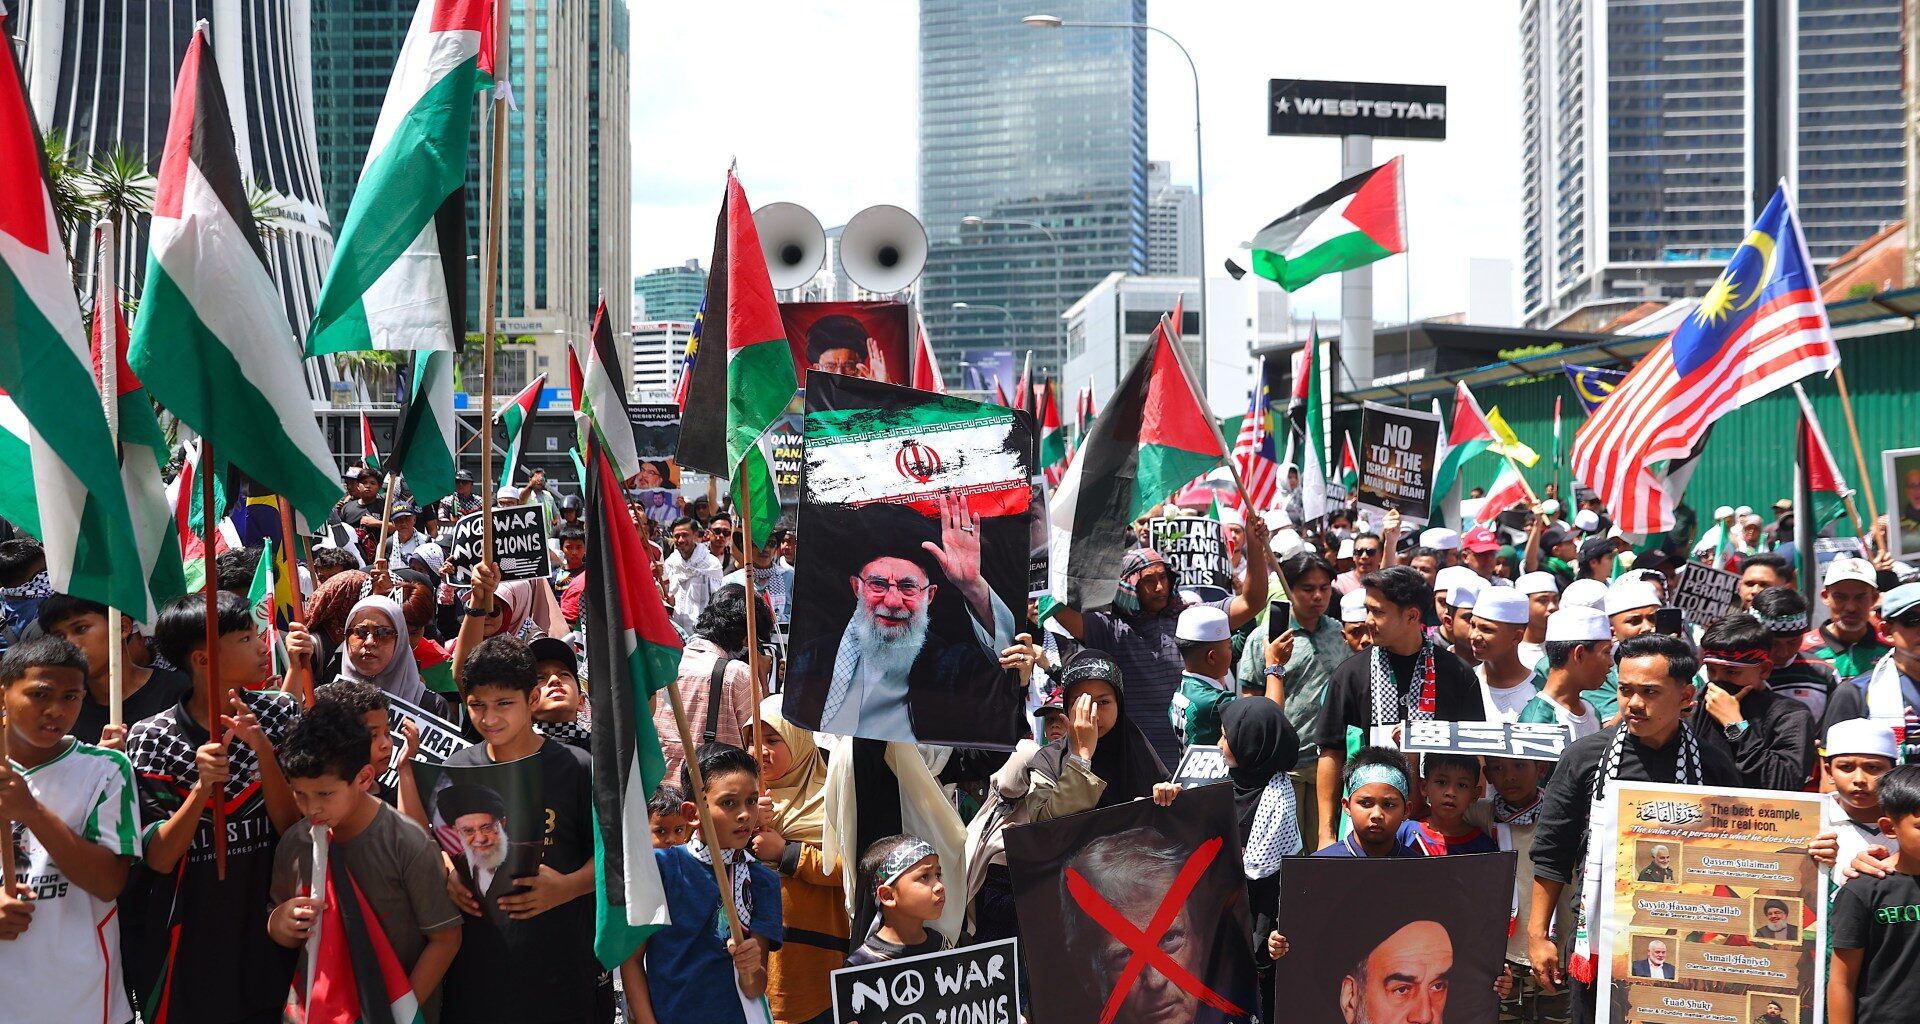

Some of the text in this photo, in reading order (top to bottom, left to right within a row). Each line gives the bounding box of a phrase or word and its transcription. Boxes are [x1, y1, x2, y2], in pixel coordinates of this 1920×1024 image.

[1294, 97, 1445, 120] WESTSTAR
[1383, 423, 1413, 450] NO
[1371, 444, 1423, 472] TO THE
[777, 474, 800, 485] LES
[1366, 461, 1424, 487] ISRAELI-U.S.
[1364, 474, 1426, 500] WAR ON IRAN!
[493, 511, 537, 532] WAR
[495, 533, 541, 556] ZIONIS
[1168, 553, 1220, 572] OLAK
[1688, 564, 1737, 592] TOLAK
[1711, 803, 1729, 815] The
[1732, 804, 1755, 817] best
[1711, 817, 1778, 832] The real icon.
[1671, 828, 1682, 837] of
[1687, 831, 1720, 840] person
[1720, 831, 1728, 839] is
[1729, 832, 1751, 841] what
[1751, 833, 1761, 842] he
[1762, 834, 1784, 843] does
[1702, 855, 1779, 870] Qassem Sulaimani
[31, 874, 59, 884] FOR
[1638, 899, 1741, 916] Sayyid Hassan Nasrallah
[1704, 953, 1770, 967] Ismail Haniyeh
[934, 954, 1006, 997] WAR
[1663, 996, 1712, 1011] Fuad Shukr
